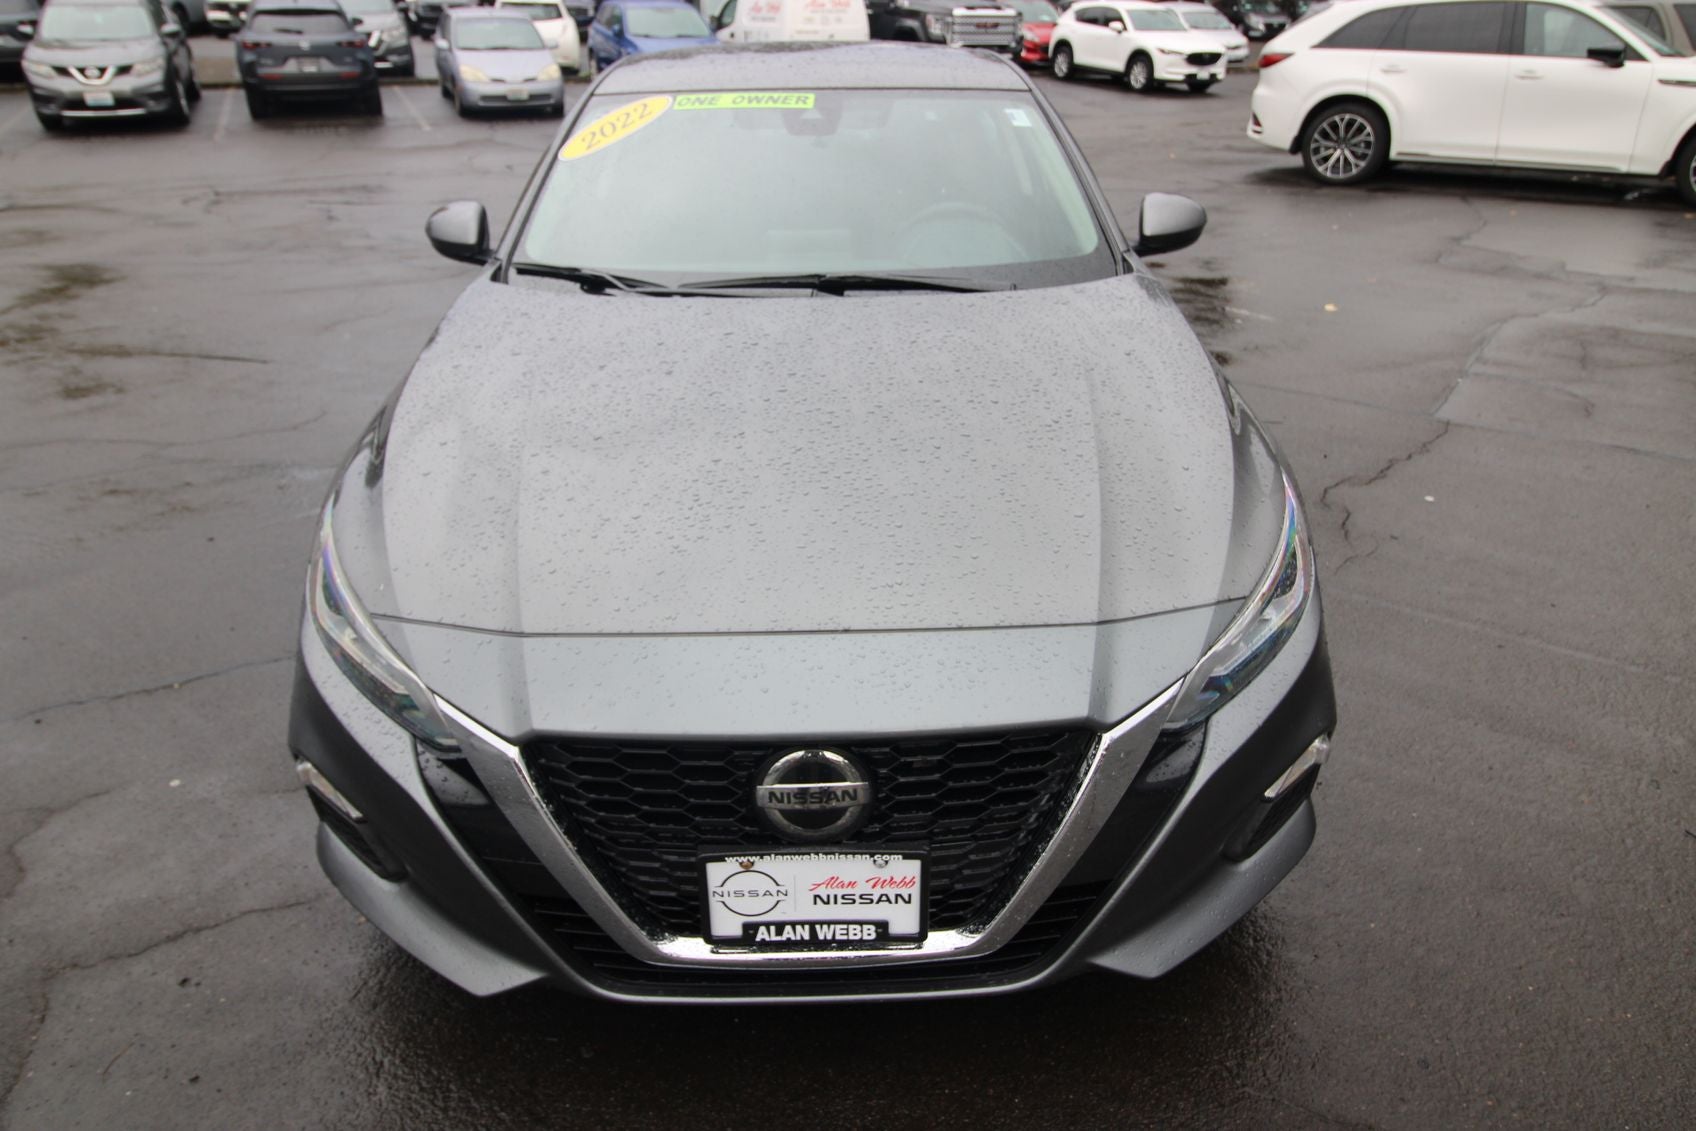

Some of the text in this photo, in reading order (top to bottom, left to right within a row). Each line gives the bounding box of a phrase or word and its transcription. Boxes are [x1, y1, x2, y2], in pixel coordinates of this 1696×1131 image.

[677, 93, 810, 108] ONE OWNER
[581, 101, 653, 151] 2022
[767, 788, 858, 805] NISSAN
[725, 853, 903, 864] www.alanwebbnissan.com
[808, 874, 917, 892] Alan Webb
[712, 888, 788, 898] NISSAN
[813, 893, 912, 906] NISSAN
[755, 924, 877, 942] ALAN WEBB
